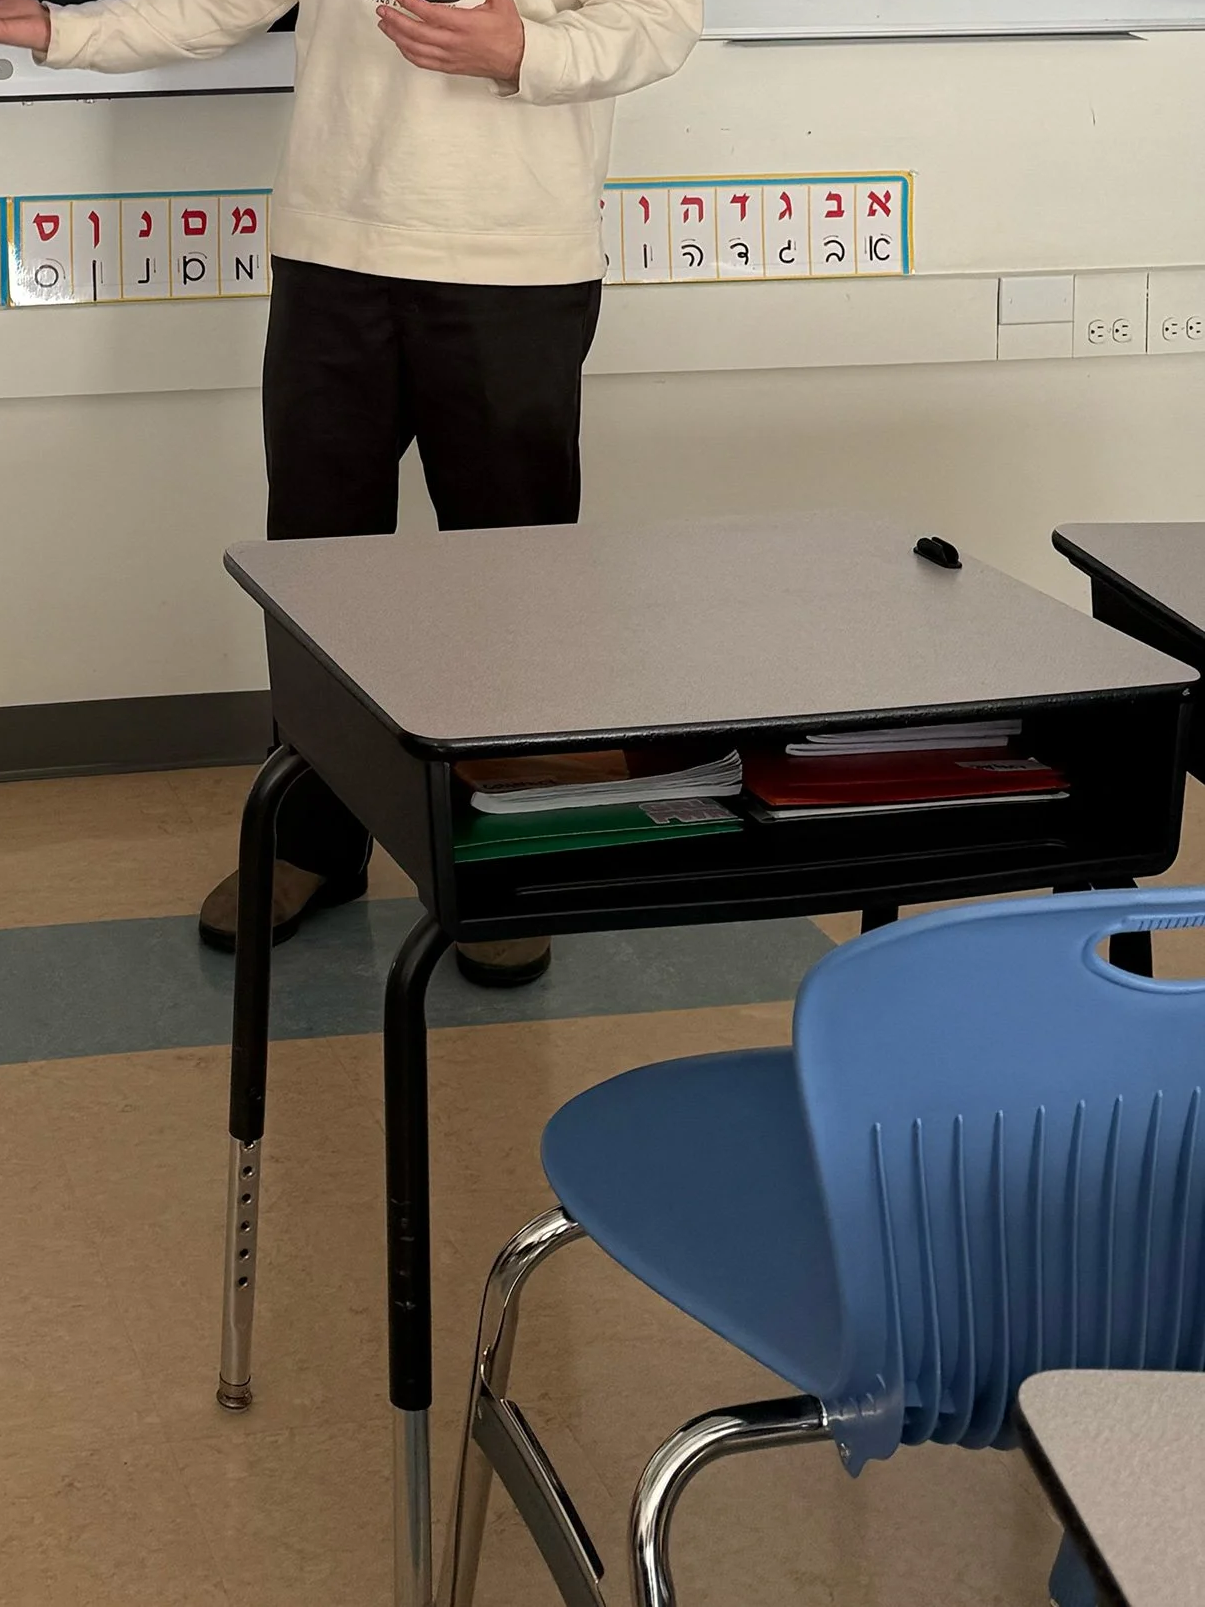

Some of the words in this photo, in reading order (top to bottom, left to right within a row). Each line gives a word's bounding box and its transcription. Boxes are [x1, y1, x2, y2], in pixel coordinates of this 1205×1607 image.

[681, 195, 704, 223] ה
[730, 193, 750, 221] ד
[779, 191, 793, 220] ג
[825, 191, 845, 217] ב
[867, 191, 892, 217] א
